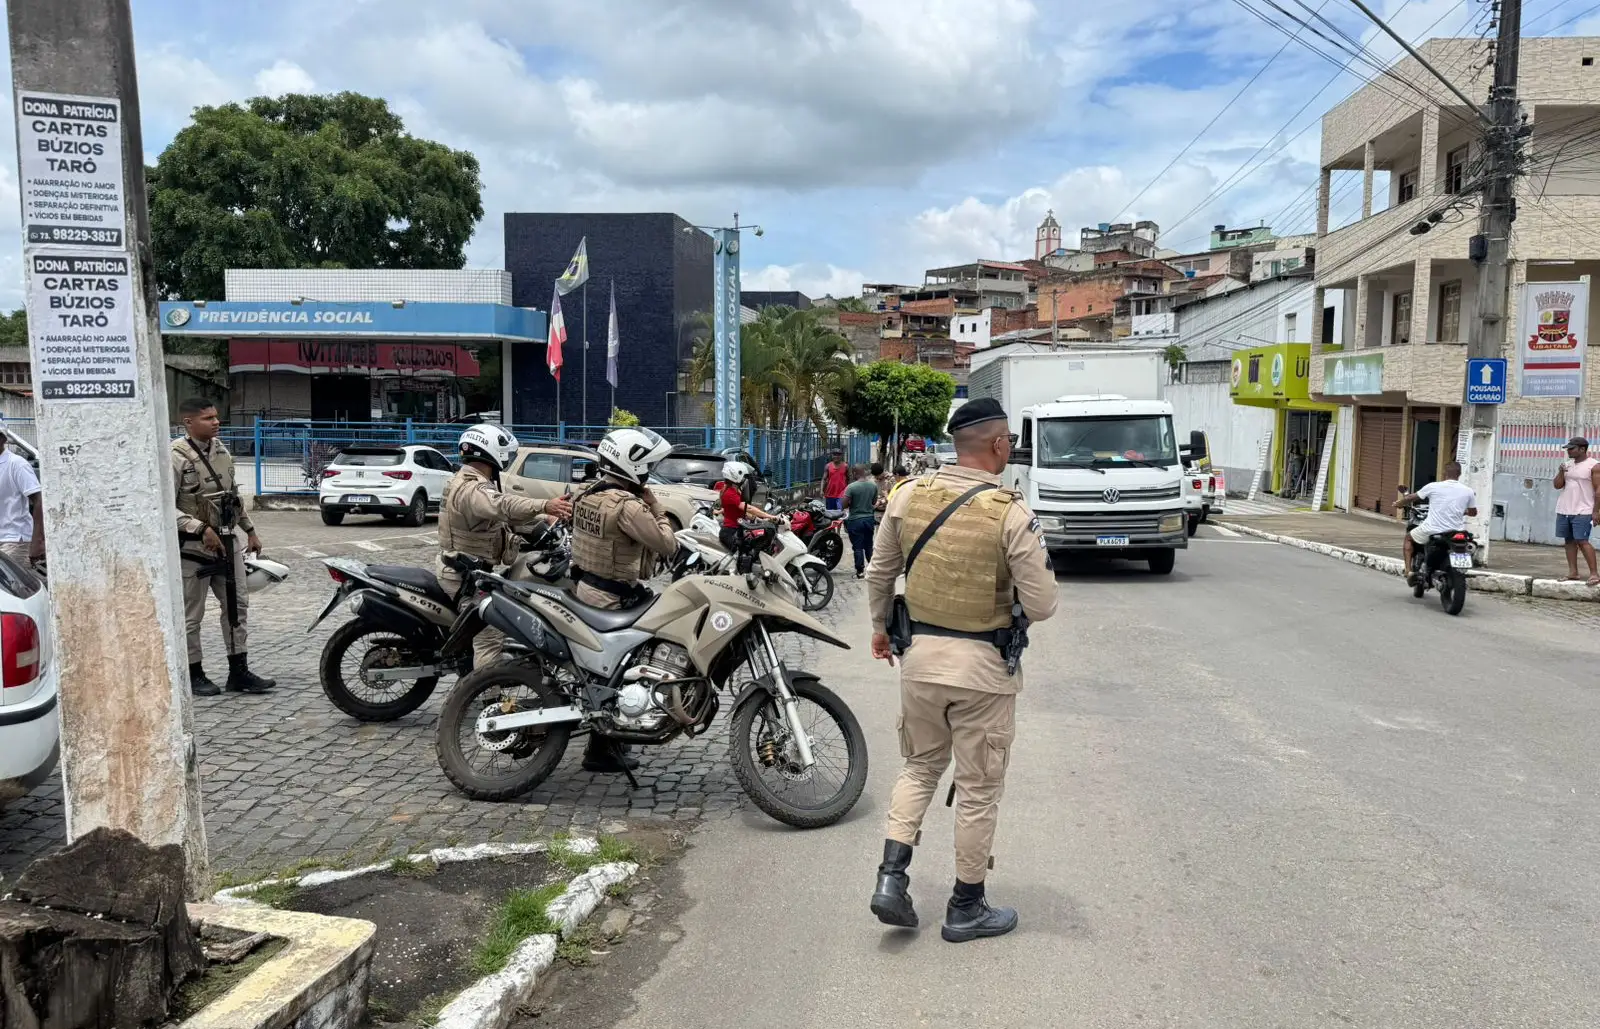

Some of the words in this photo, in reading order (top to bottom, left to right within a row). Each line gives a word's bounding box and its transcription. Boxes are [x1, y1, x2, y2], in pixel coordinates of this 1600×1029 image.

[24, 101, 58, 115] DONA
[63, 104, 115, 119] PATRÍCIA
[32, 120, 108, 137] CARTAS
[38, 137, 104, 156] BÚZIOS
[46, 157, 97, 174] TARÔ
[33, 178, 80, 190] AMARRAÇÃO
[81, 181, 93, 189] NO
[94, 182, 116, 190] AMOR
[33, 190, 69, 200] DOENÇAS
[33, 201, 78, 212] SEPARAÇÃO
[80, 203, 119, 212] DEFINITIVA
[34, 210, 59, 220] VÍCIOS
[73, 214, 103, 222] BEBIDAS
[52, 228, 118, 243] 98229-3817
[35, 259, 70, 272] DONA
[74, 258, 126, 273] PATRÍCIA
[44, 277, 119, 291] CARTAS
[50, 293, 115, 309] BÚZIOS
[728, 265, 736, 328] SOCIAL
[58, 312, 109, 328] TARÔ
[199, 308, 309, 323] PREVIDÊNCIA
[313, 311, 374, 323] SOCIAL
[46, 334, 92, 344] AMARRAÇÃO
[46, 345, 82, 356] DOENÇAS
[47, 355, 91, 366] SEPARAÇÃO
[48, 366, 72, 375] VÍCIOS
[86, 367, 116, 375] BEBIDAS
[66, 383, 131, 395] 98229-3817
[1470, 392, 1501, 400] CASARÃO
[466, 433, 489, 445] MILITAR
[575, 517, 601, 535] MILITAR
[398, 582, 427, 593] HONDA
[536, 588, 562, 600] HONDA
[735, 589, 766, 608] MILITAR
